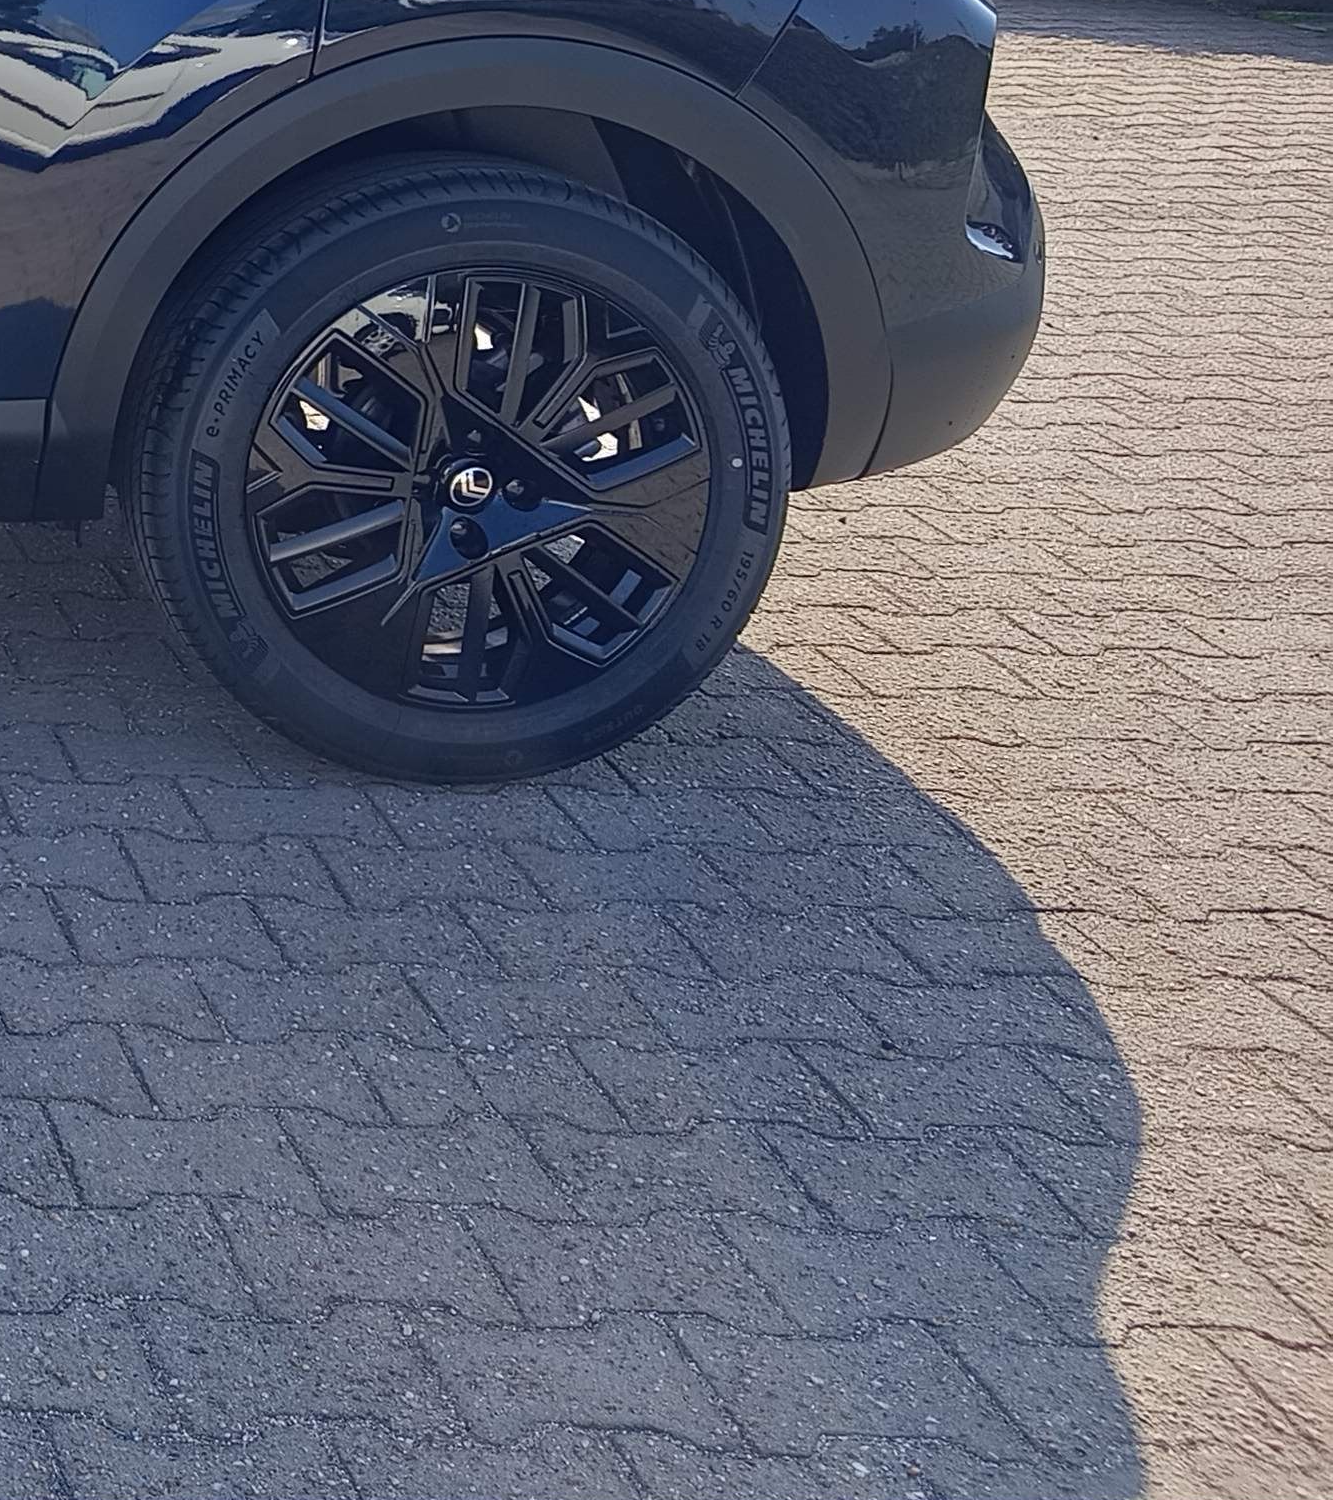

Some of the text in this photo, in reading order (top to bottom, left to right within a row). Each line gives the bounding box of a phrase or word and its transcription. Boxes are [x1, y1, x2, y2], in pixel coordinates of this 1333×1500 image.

[729, 366, 771, 523] MICHELIN
[191, 460, 238, 618] MICHELIN
[722, 550, 756, 613] 195/60
[712, 617, 723, 630] R
